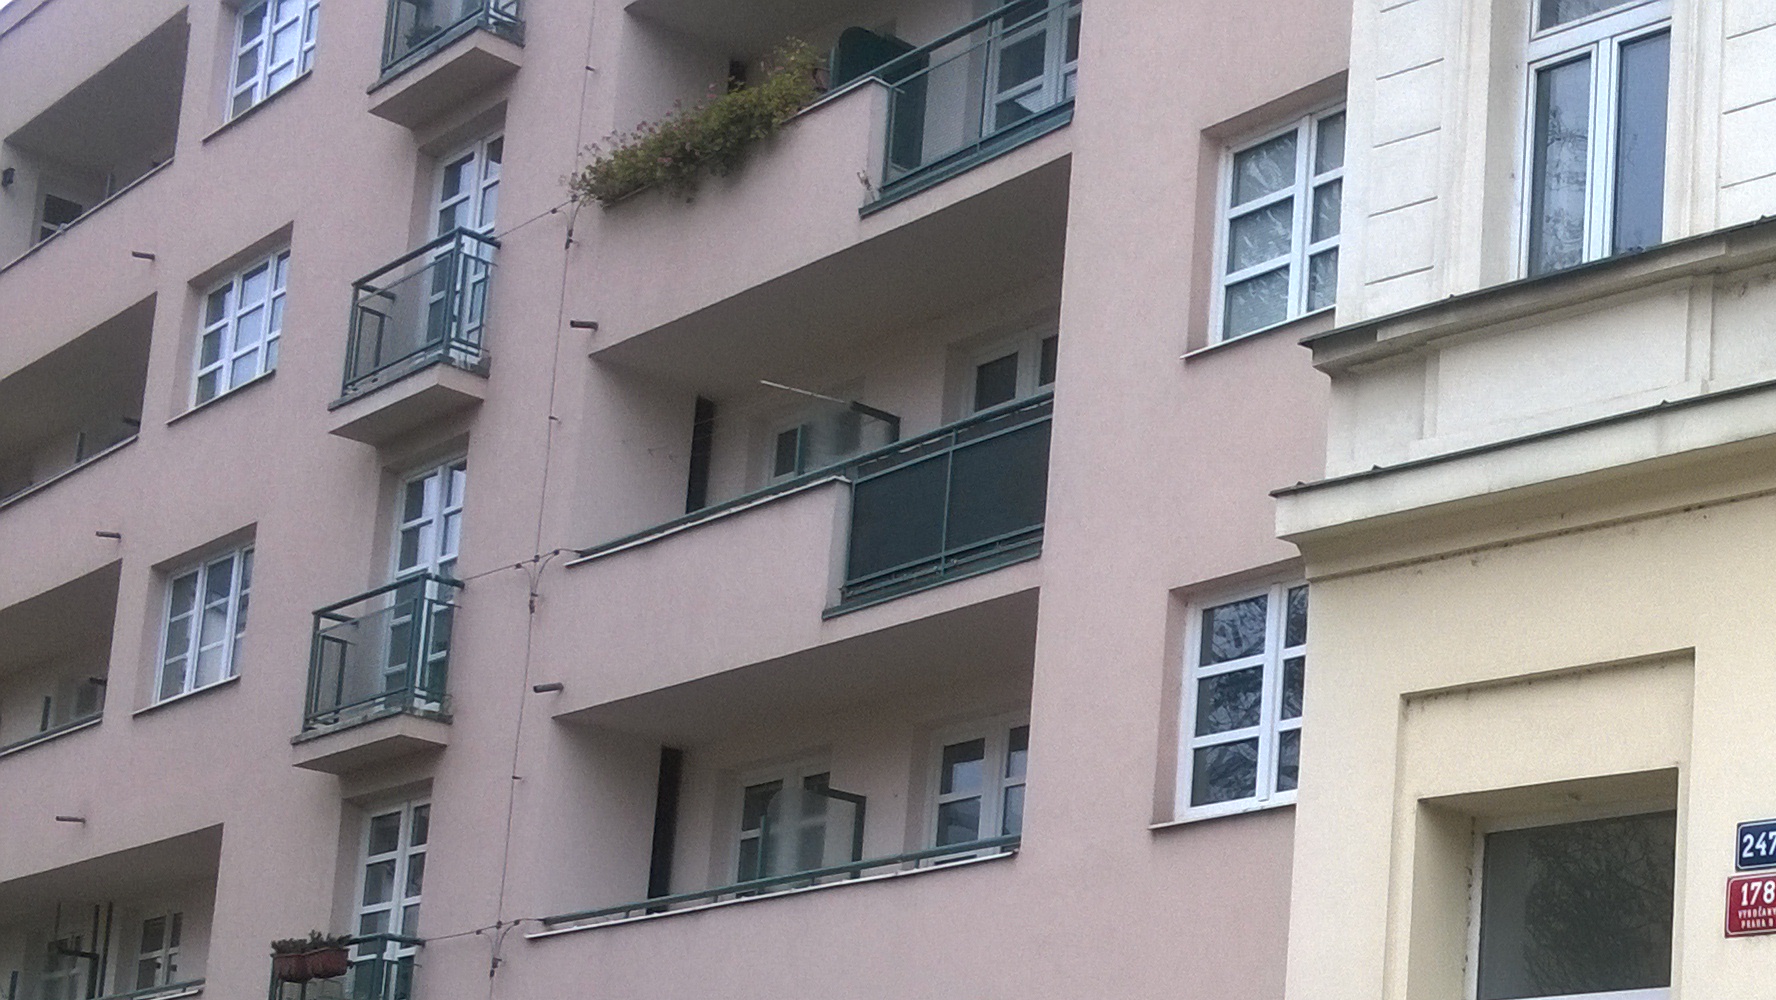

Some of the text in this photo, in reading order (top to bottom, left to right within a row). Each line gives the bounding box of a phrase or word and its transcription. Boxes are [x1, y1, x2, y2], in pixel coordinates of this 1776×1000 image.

[1741, 880, 1776, 906] 178
[1738, 906, 1776, 919] VYSOČANY
[1741, 919, 1766, 929] PRAHA
